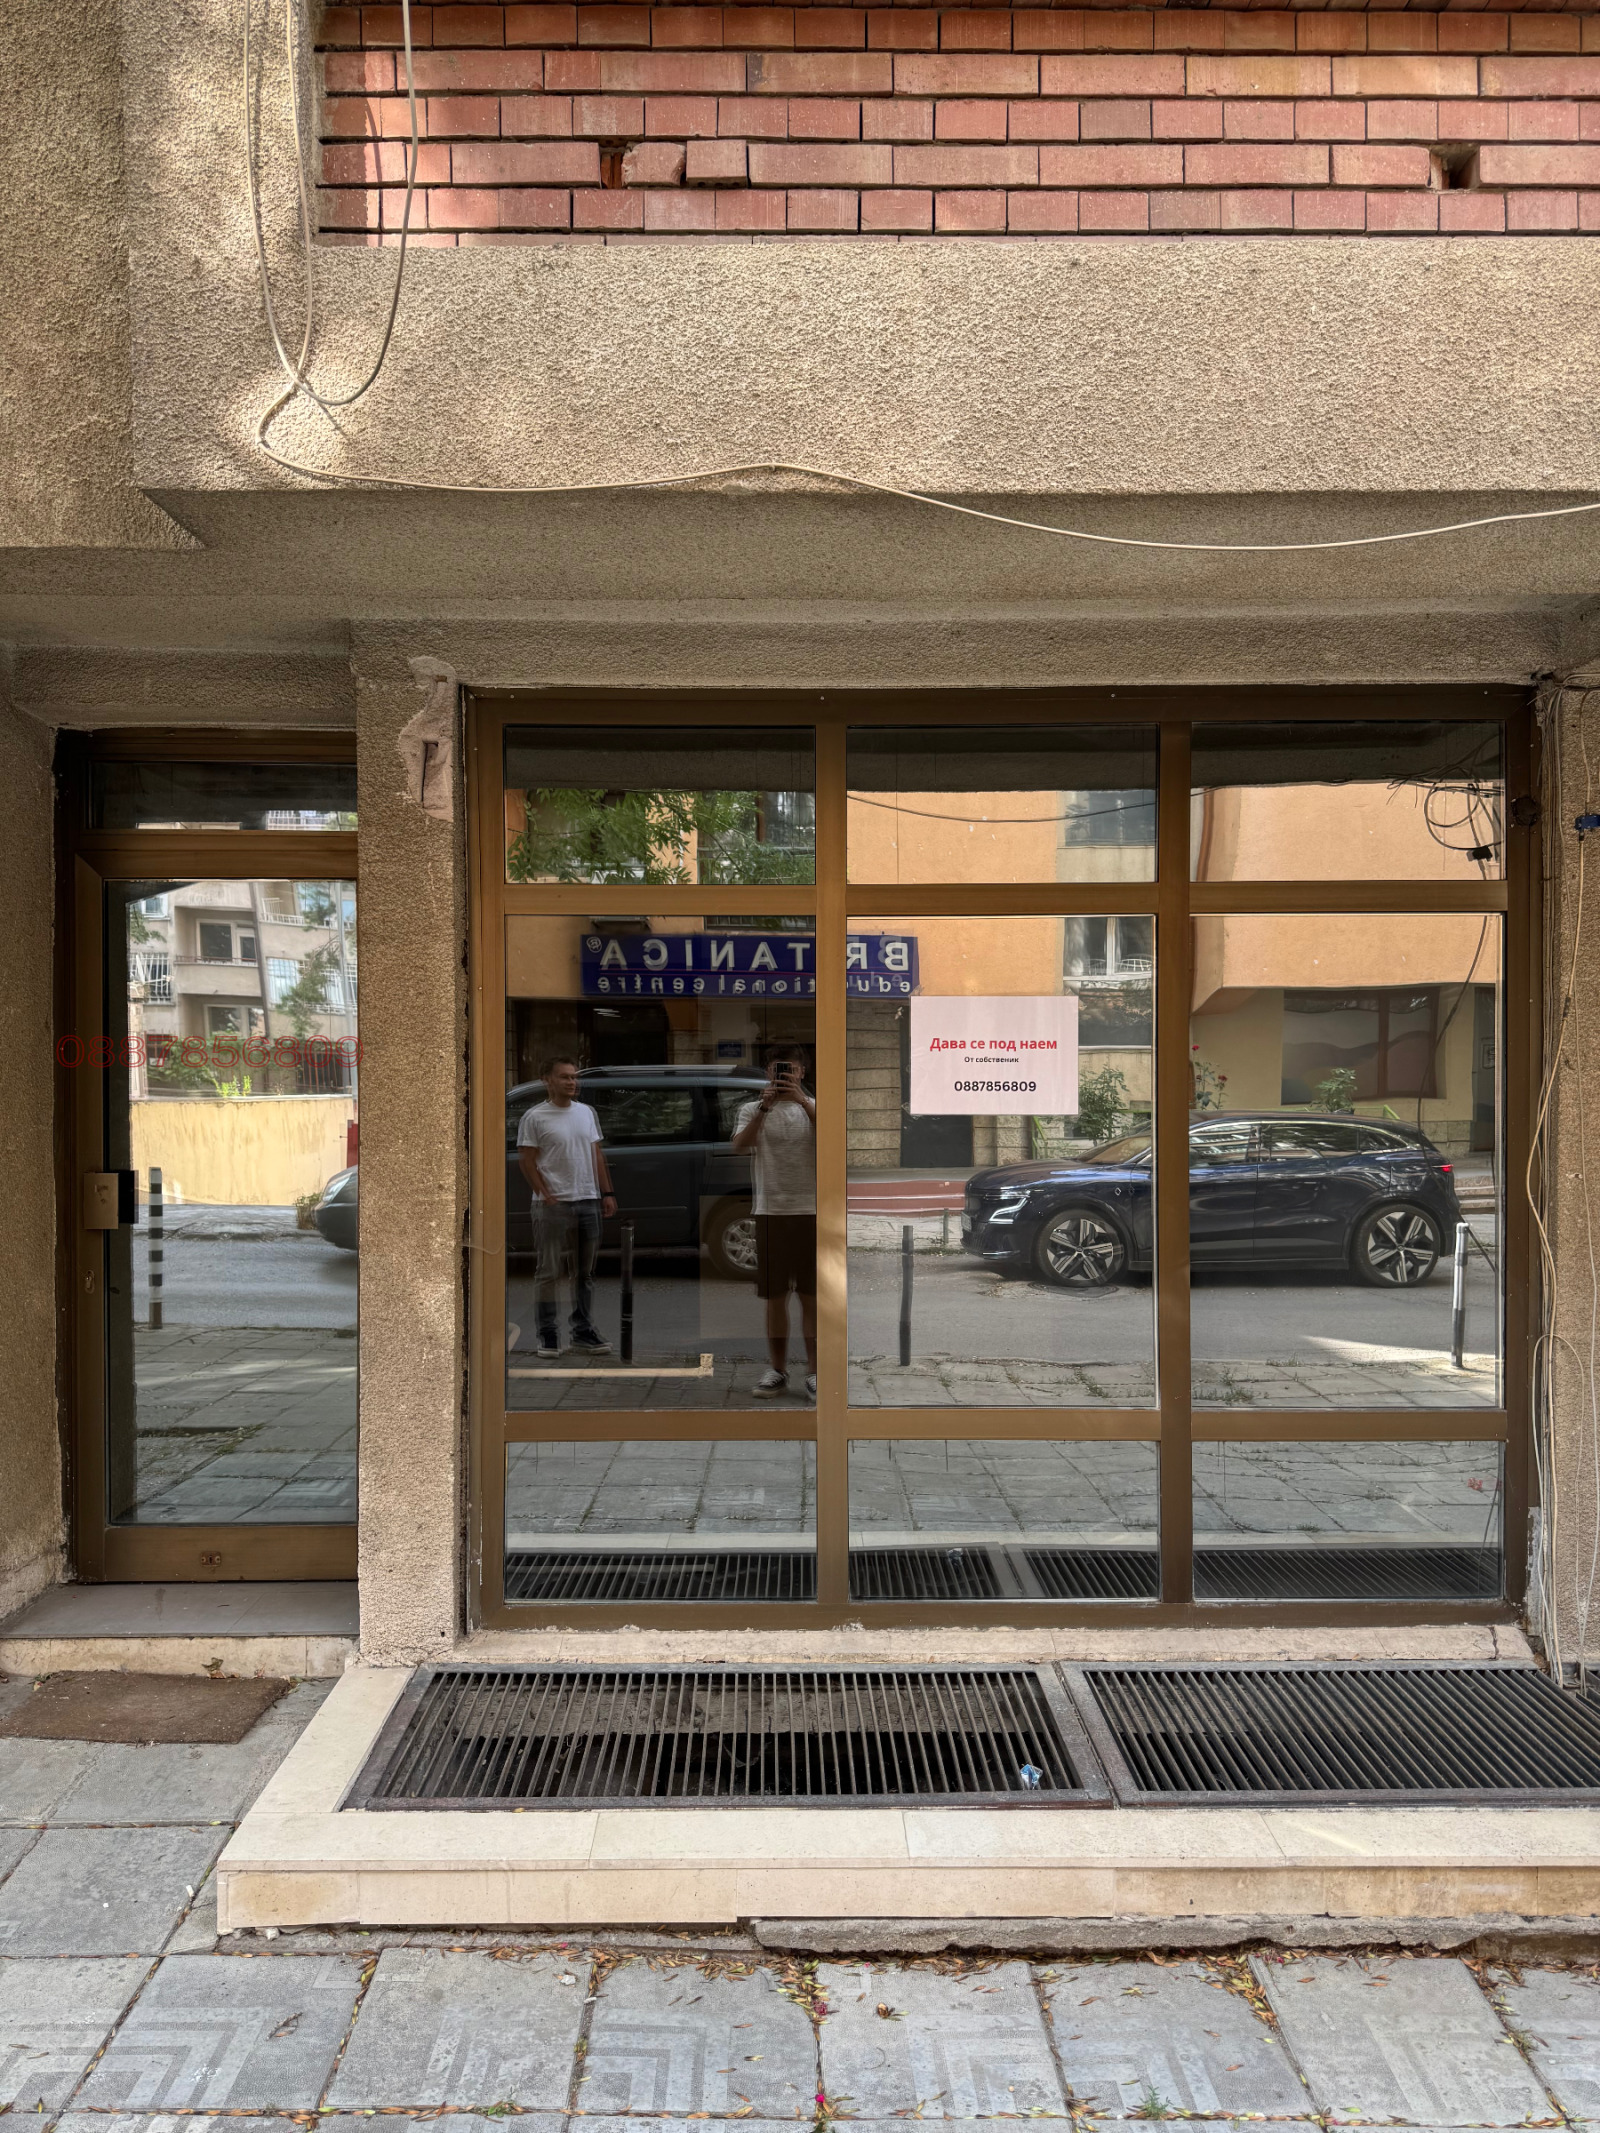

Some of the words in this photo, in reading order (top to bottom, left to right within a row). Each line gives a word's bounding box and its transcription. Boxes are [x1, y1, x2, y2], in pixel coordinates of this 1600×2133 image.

[930, 1037, 967, 1052] Дава
[970, 1040, 986, 1050] се
[989, 1040, 1017, 1052] под
[1020, 1040, 1057, 1050] наем
[954, 1080, 1037, 1092] 0887856809
